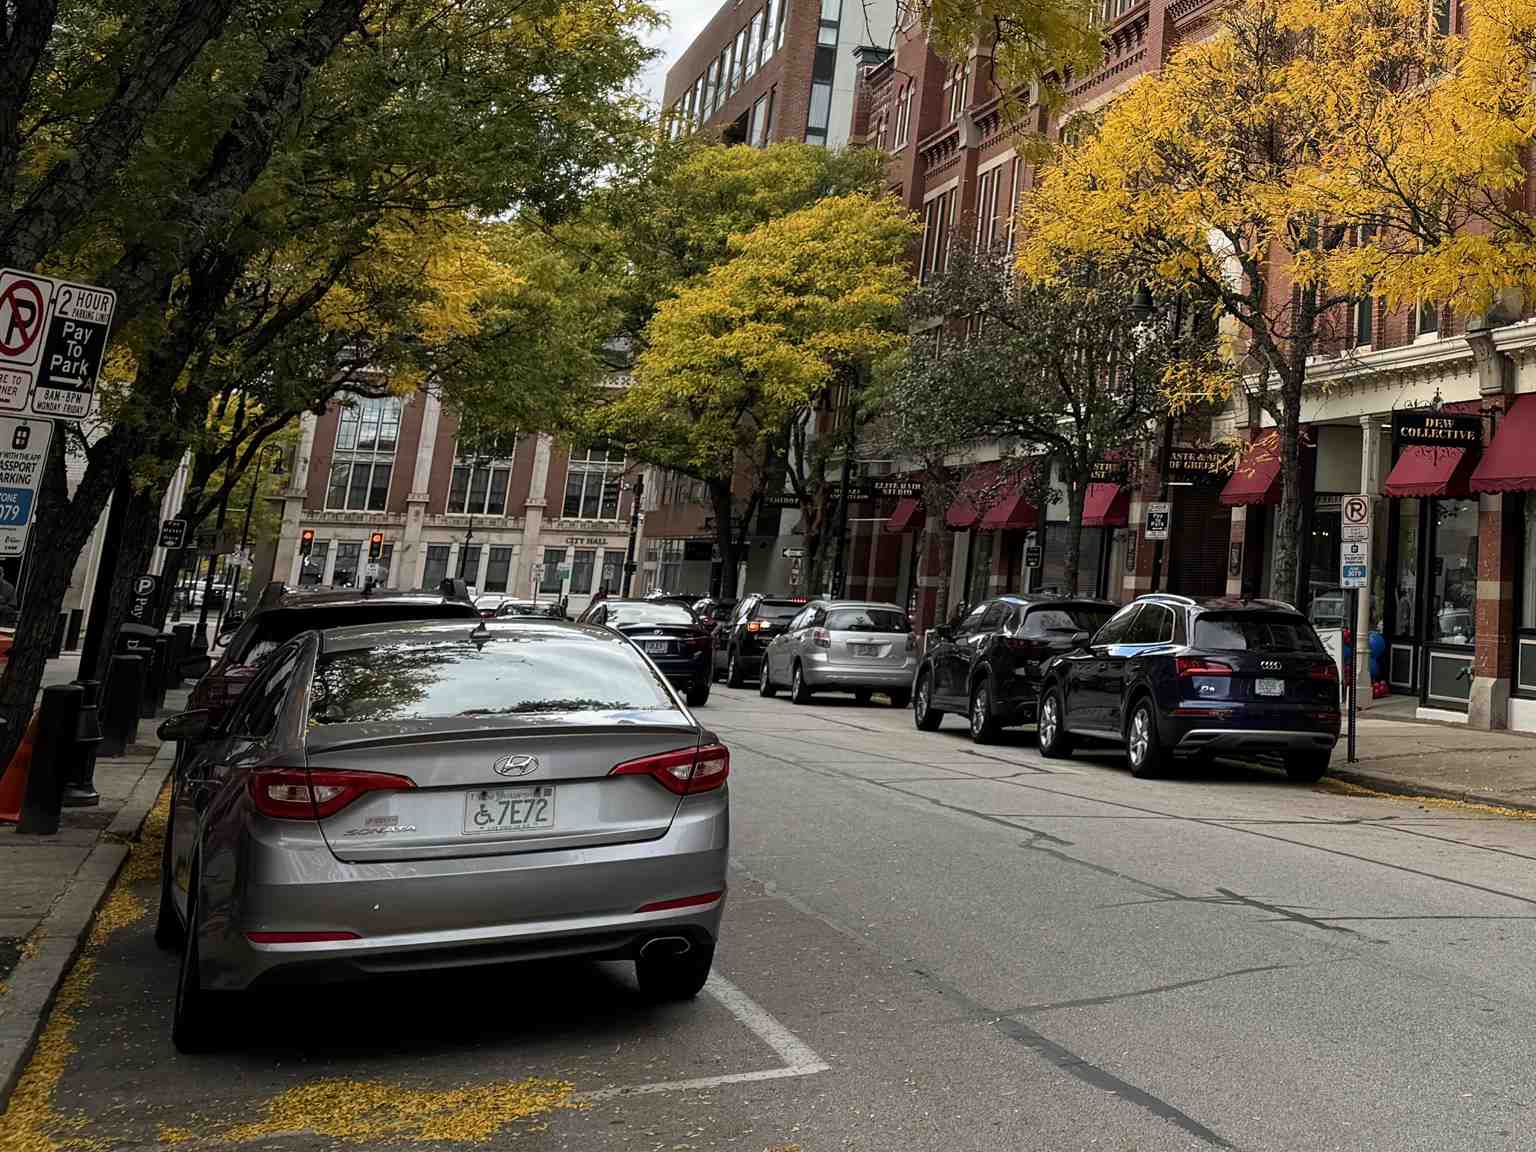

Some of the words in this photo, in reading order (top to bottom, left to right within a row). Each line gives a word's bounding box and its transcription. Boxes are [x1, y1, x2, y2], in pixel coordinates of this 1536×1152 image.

[58, 289, 73, 315] 2
[75, 291, 110, 312] HOUR
[62, 321, 94, 345] Pay
[66, 340, 83, 358] To
[50, 354, 89, 376] Park
[12, 375, 22, 386] TO
[1425, 418, 1454, 428] DEW
[1400, 427, 1476, 441] COLLECTIVE
[499, 799, 548, 825] 7E72
[344, 824, 417, 837] SONATA
